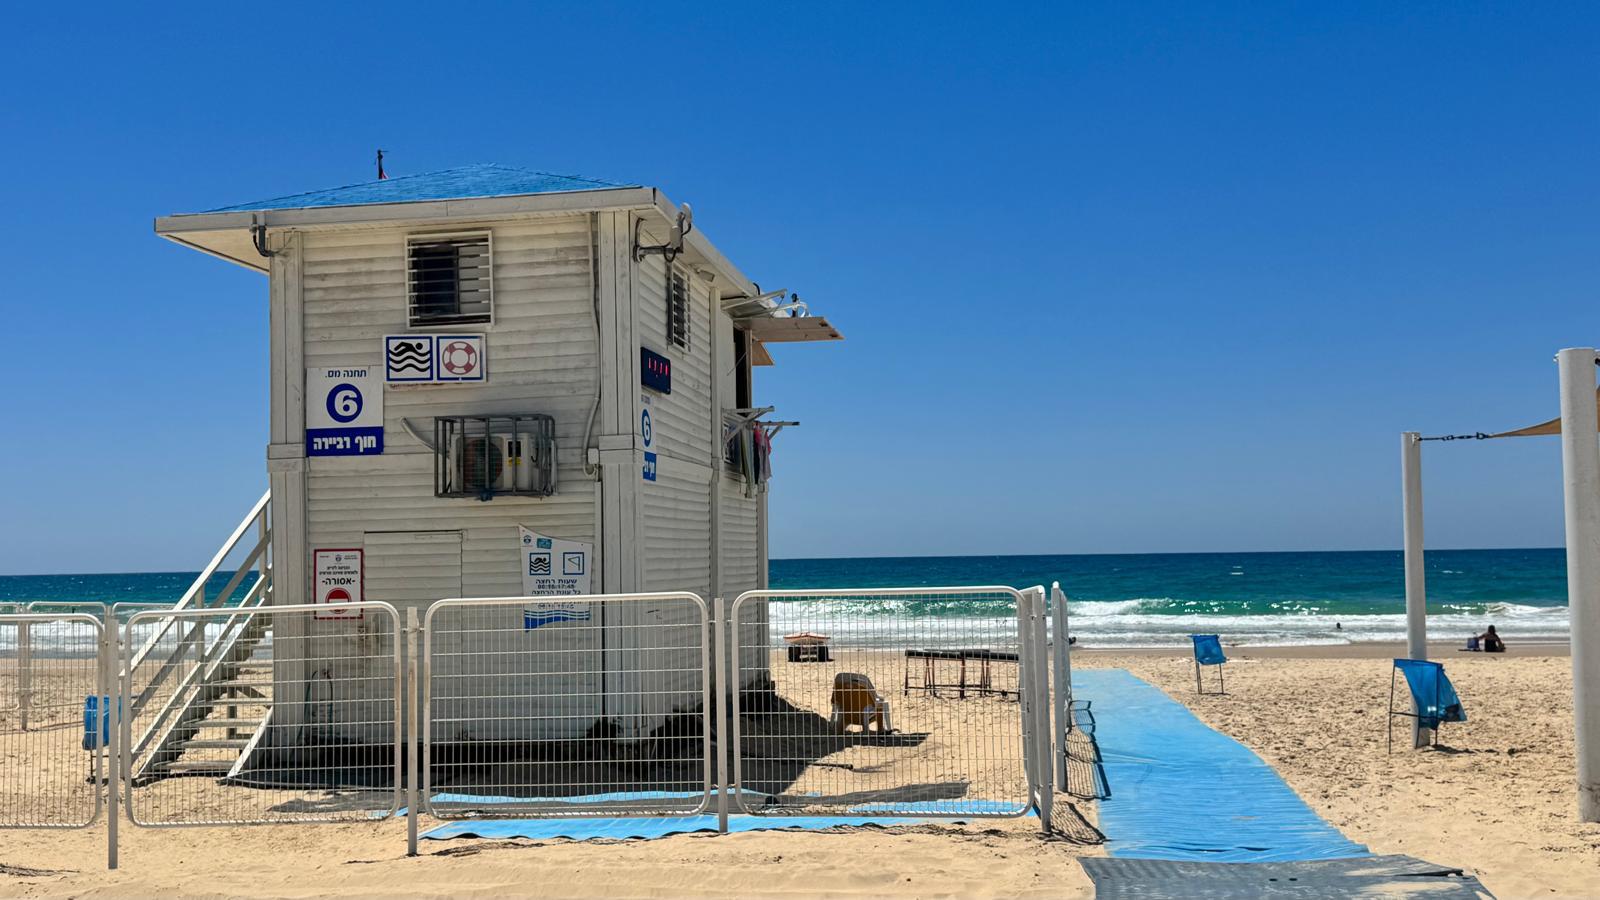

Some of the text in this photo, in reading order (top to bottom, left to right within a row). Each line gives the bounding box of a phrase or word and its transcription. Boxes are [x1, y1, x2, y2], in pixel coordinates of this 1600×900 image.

[343, 369, 367, 377] תחנה
[334, 389, 358, 416] 6
[643, 415, 650, 441] 6
[313, 435, 376, 452] חוף רביירה
